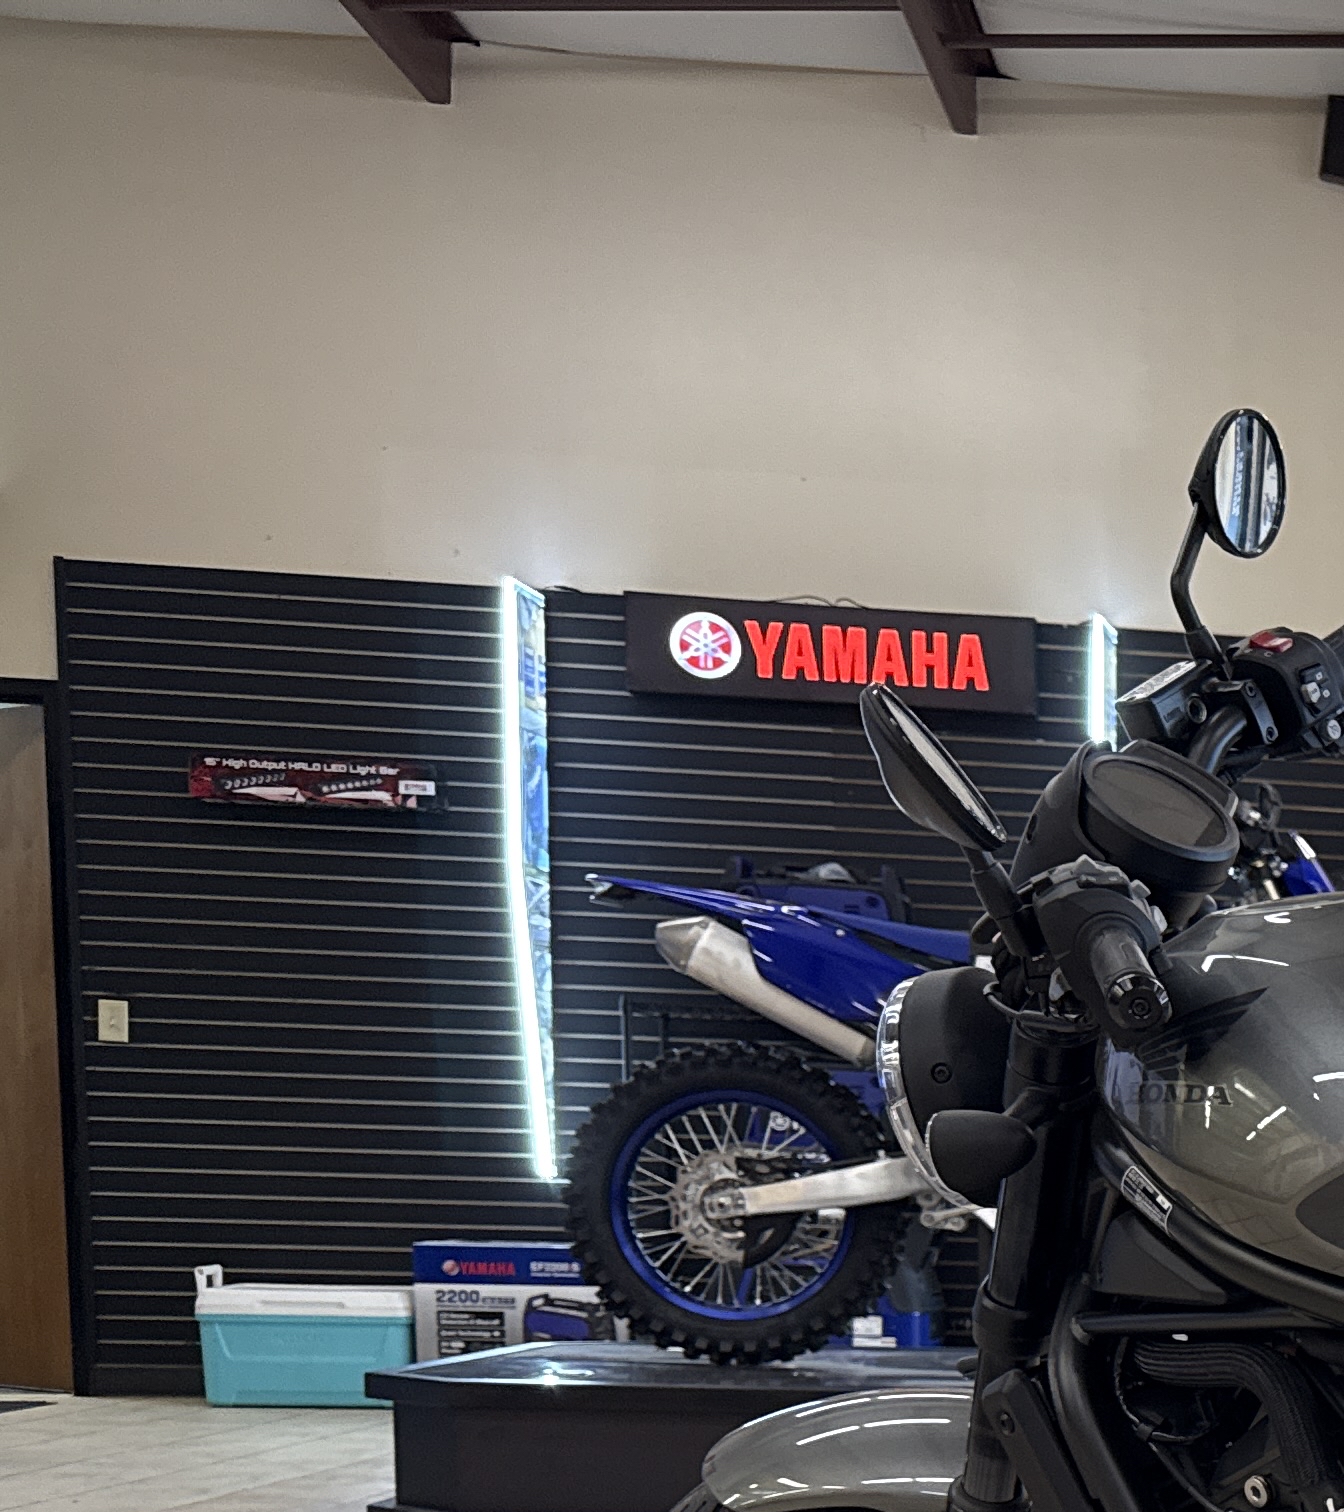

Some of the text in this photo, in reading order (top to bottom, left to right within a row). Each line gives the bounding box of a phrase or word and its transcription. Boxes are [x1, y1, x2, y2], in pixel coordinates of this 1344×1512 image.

[744, 618, 990, 692] YAMAHA
[222, 757, 247, 770] High
[249, 759, 287, 771] Output
[288, 761, 321, 772] HALO
[323, 763, 347, 773] LED
[349, 764, 377, 776] Light
[379, 766, 400, 776] Bar
[459, 1261, 516, 1277] YAMAHA
[435, 1289, 480, 1304] 2200
